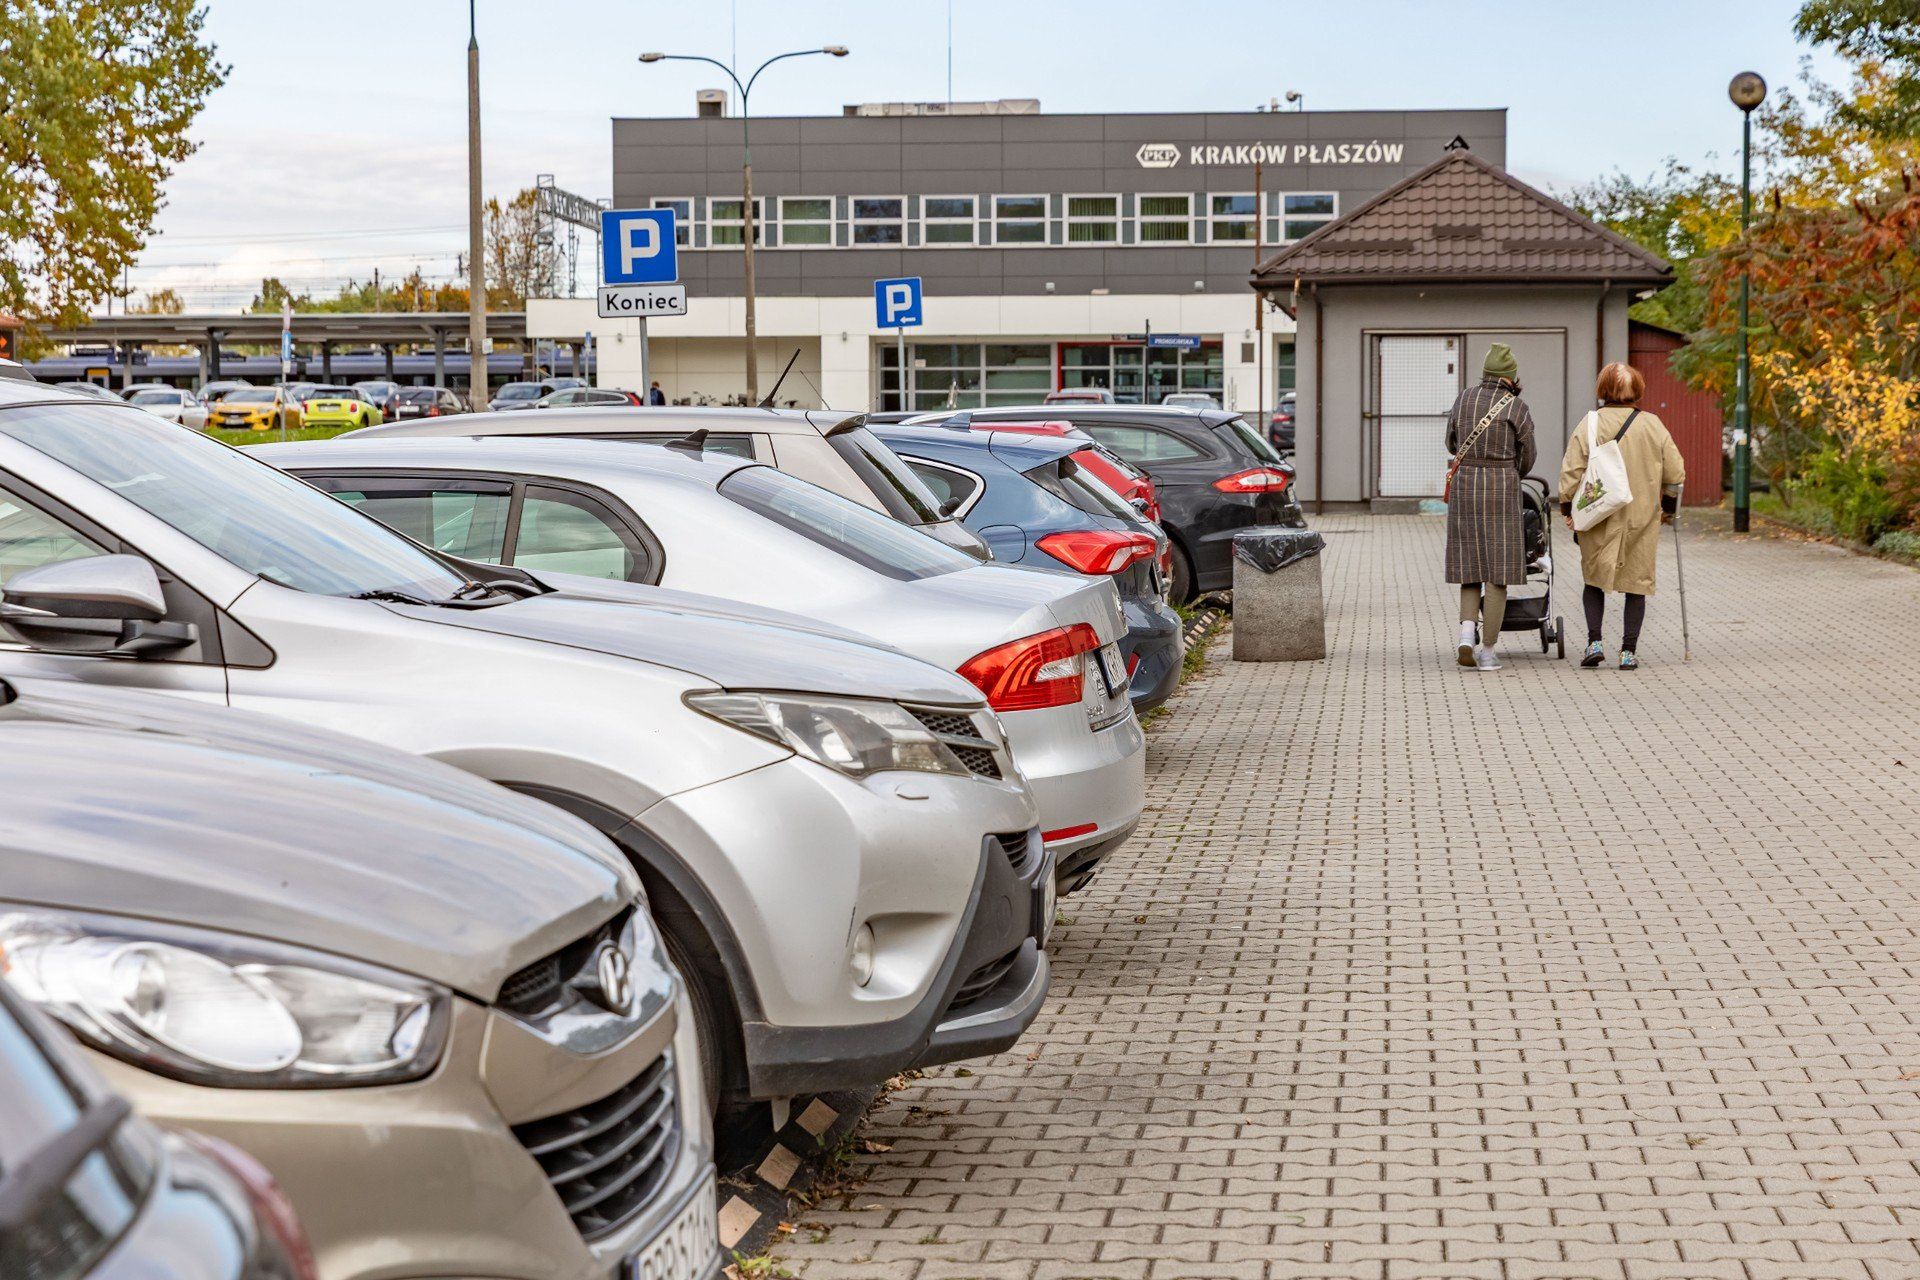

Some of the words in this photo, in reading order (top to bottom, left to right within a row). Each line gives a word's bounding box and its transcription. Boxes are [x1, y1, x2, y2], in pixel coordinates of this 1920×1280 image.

[1143, 150, 1175, 161] PKP
[1190, 141, 1287, 165] KRAKÓW
[1294, 139, 1404, 164] PŁASZÓW
[619, 218, 661, 275] P
[606, 292, 678, 311] Koniec
[885, 283, 912, 323] P
